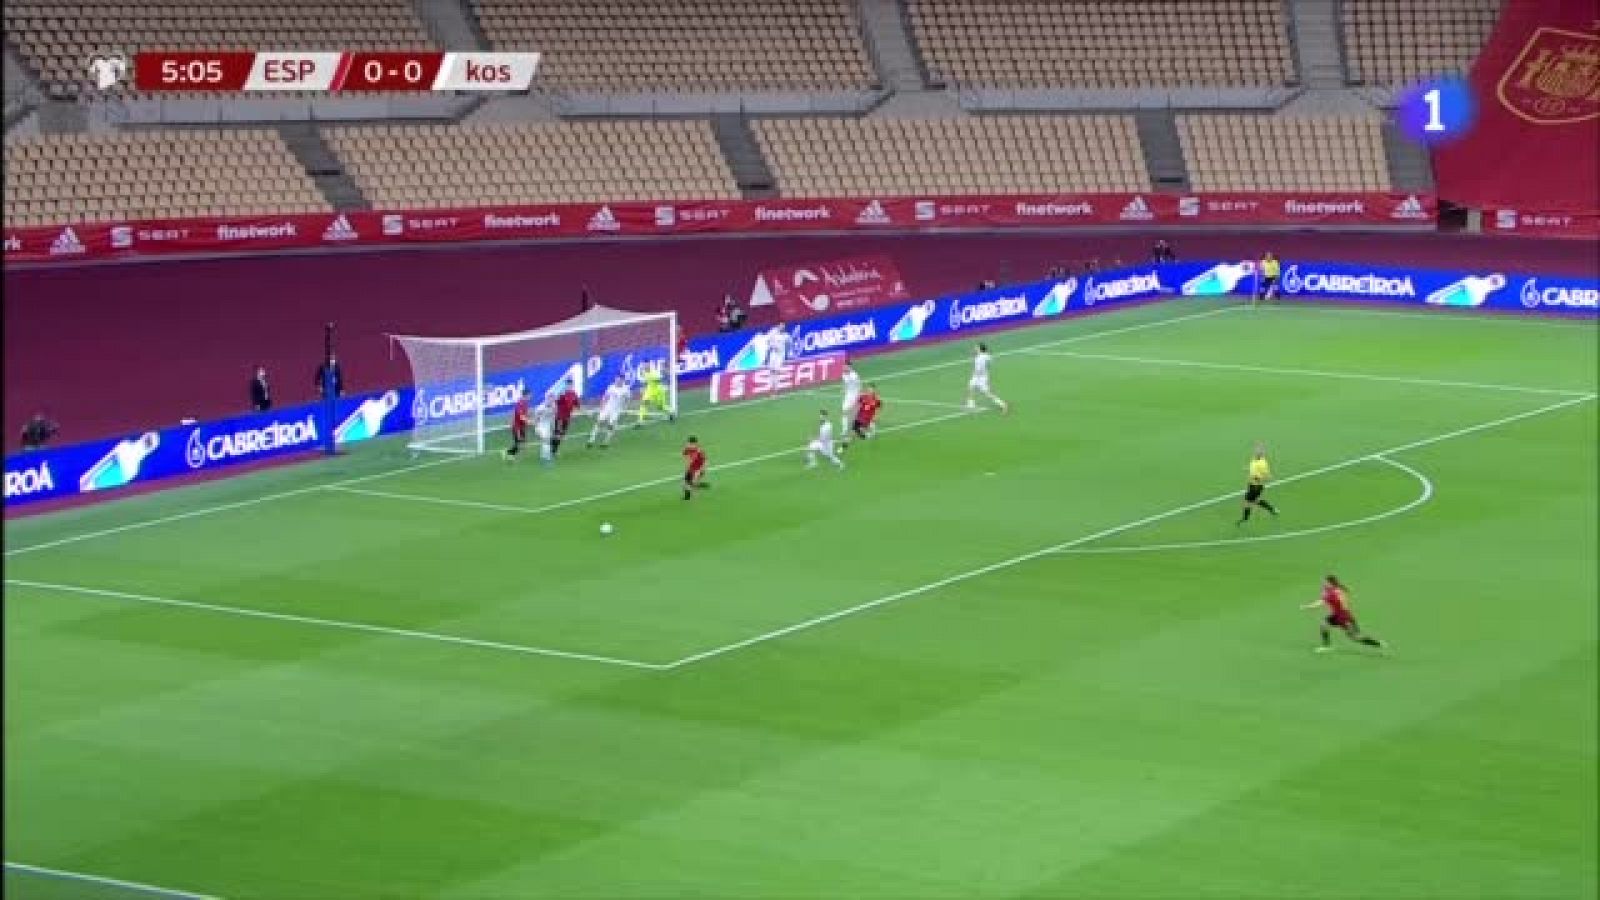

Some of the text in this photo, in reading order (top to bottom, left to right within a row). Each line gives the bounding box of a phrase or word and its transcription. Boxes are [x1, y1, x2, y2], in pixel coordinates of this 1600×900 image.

[216, 222, 297, 240] finetwork
[754, 205, 830, 221] finetwork
[1016, 201, 1093, 216] finetwork
[1284, 199, 1365, 214] finetwork
[751, 358, 836, 394] SEAT
